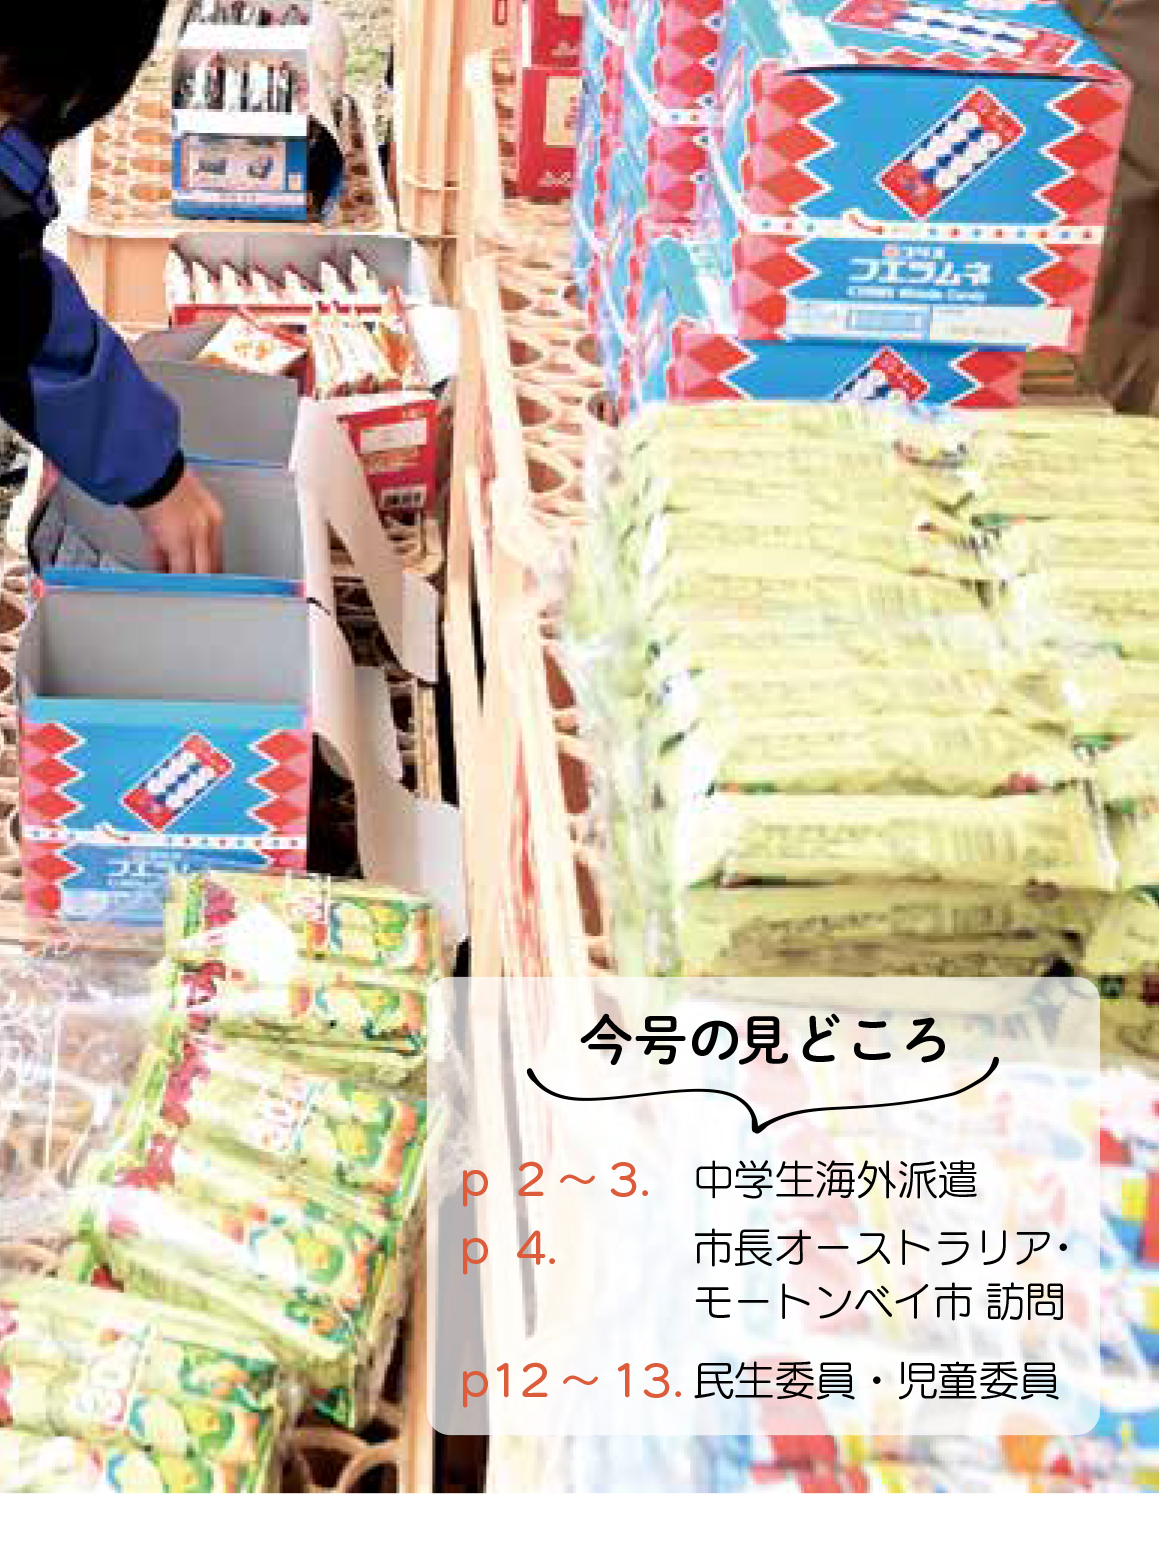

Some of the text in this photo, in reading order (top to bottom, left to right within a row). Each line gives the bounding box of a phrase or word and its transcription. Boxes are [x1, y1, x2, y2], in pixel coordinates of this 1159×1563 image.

[847, 256, 992, 287] フエラムネ
